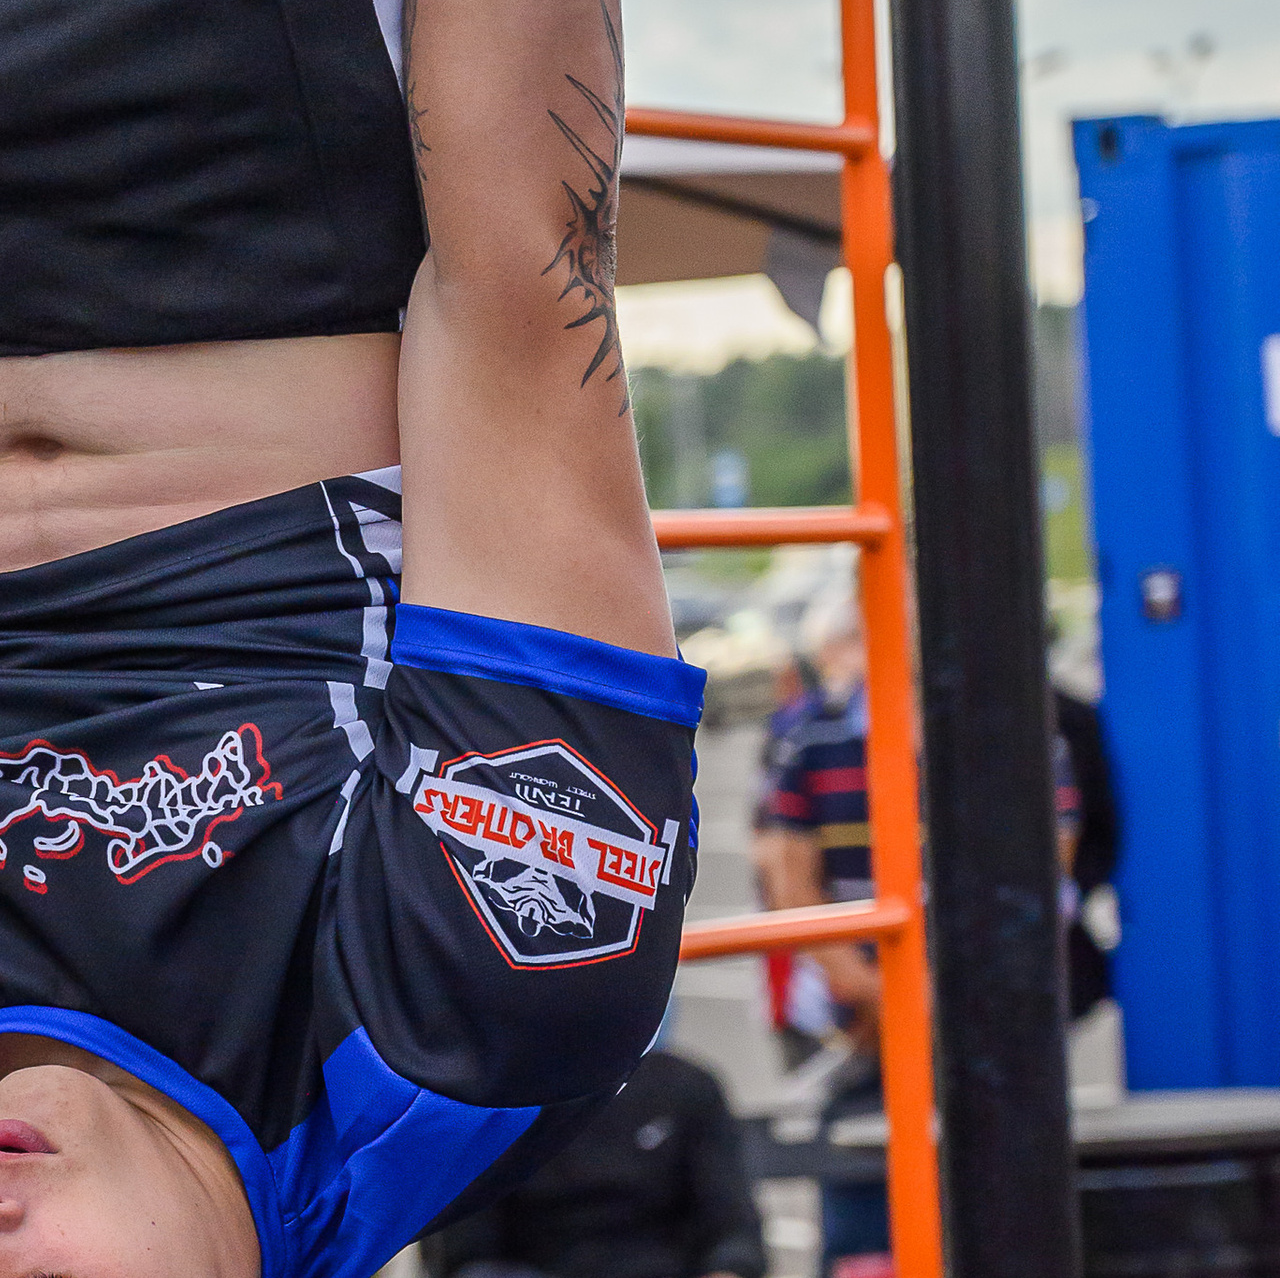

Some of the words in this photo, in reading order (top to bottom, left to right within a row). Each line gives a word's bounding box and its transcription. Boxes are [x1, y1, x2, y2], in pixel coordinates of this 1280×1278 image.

[509, 771, 558, 789] WORKOUT
[515, 782, 585, 818] TEAM
[413, 788, 576, 870] BROTHERS
[586, 837, 662, 897] STEEL
